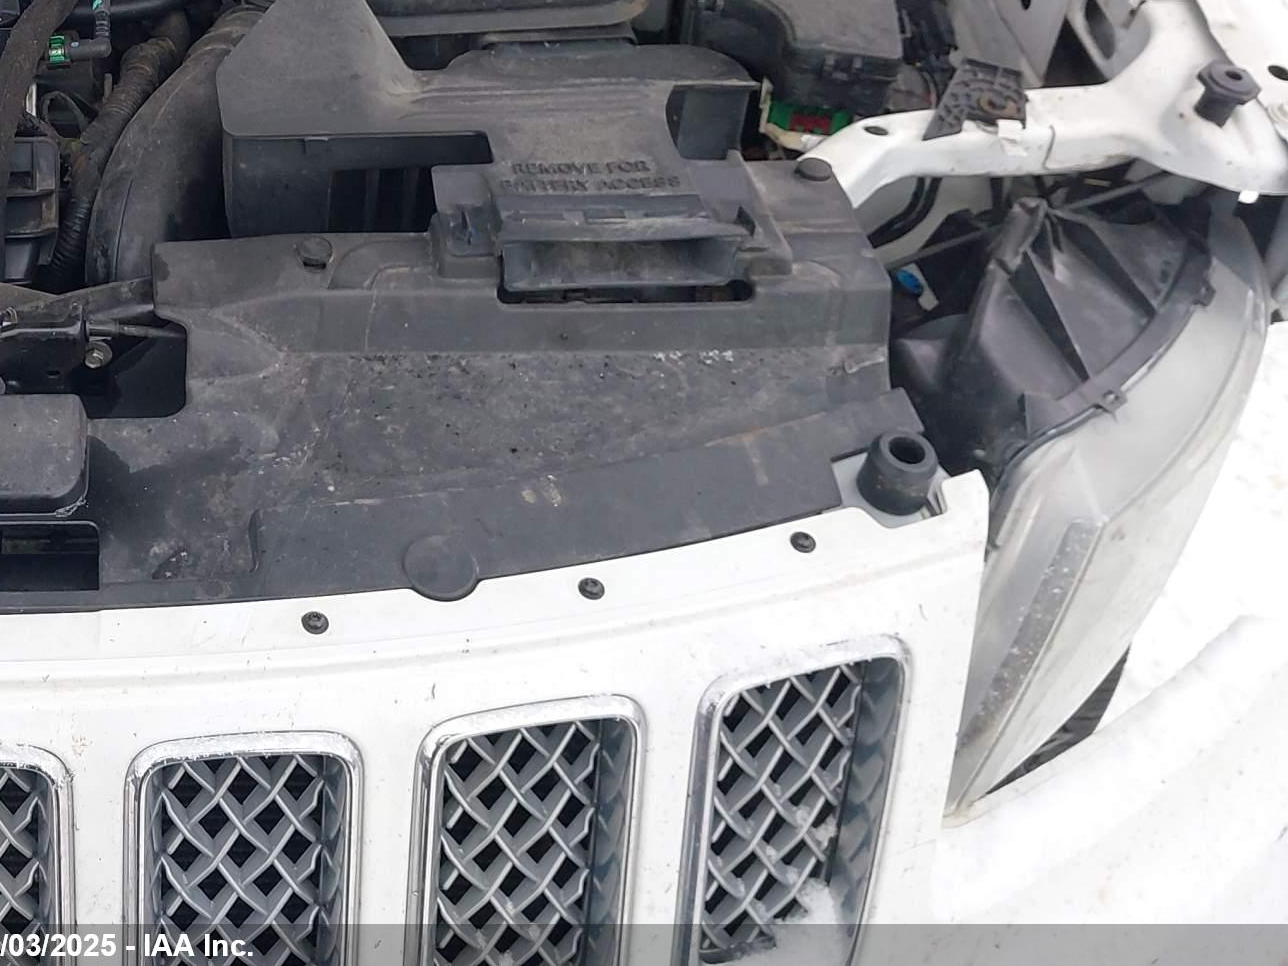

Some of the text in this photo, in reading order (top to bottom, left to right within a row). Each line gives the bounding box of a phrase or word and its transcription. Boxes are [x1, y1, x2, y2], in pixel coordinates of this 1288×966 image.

[512, 160, 651, 176] REMOVE FOR
[597, 175, 681, 191] ACCESS
